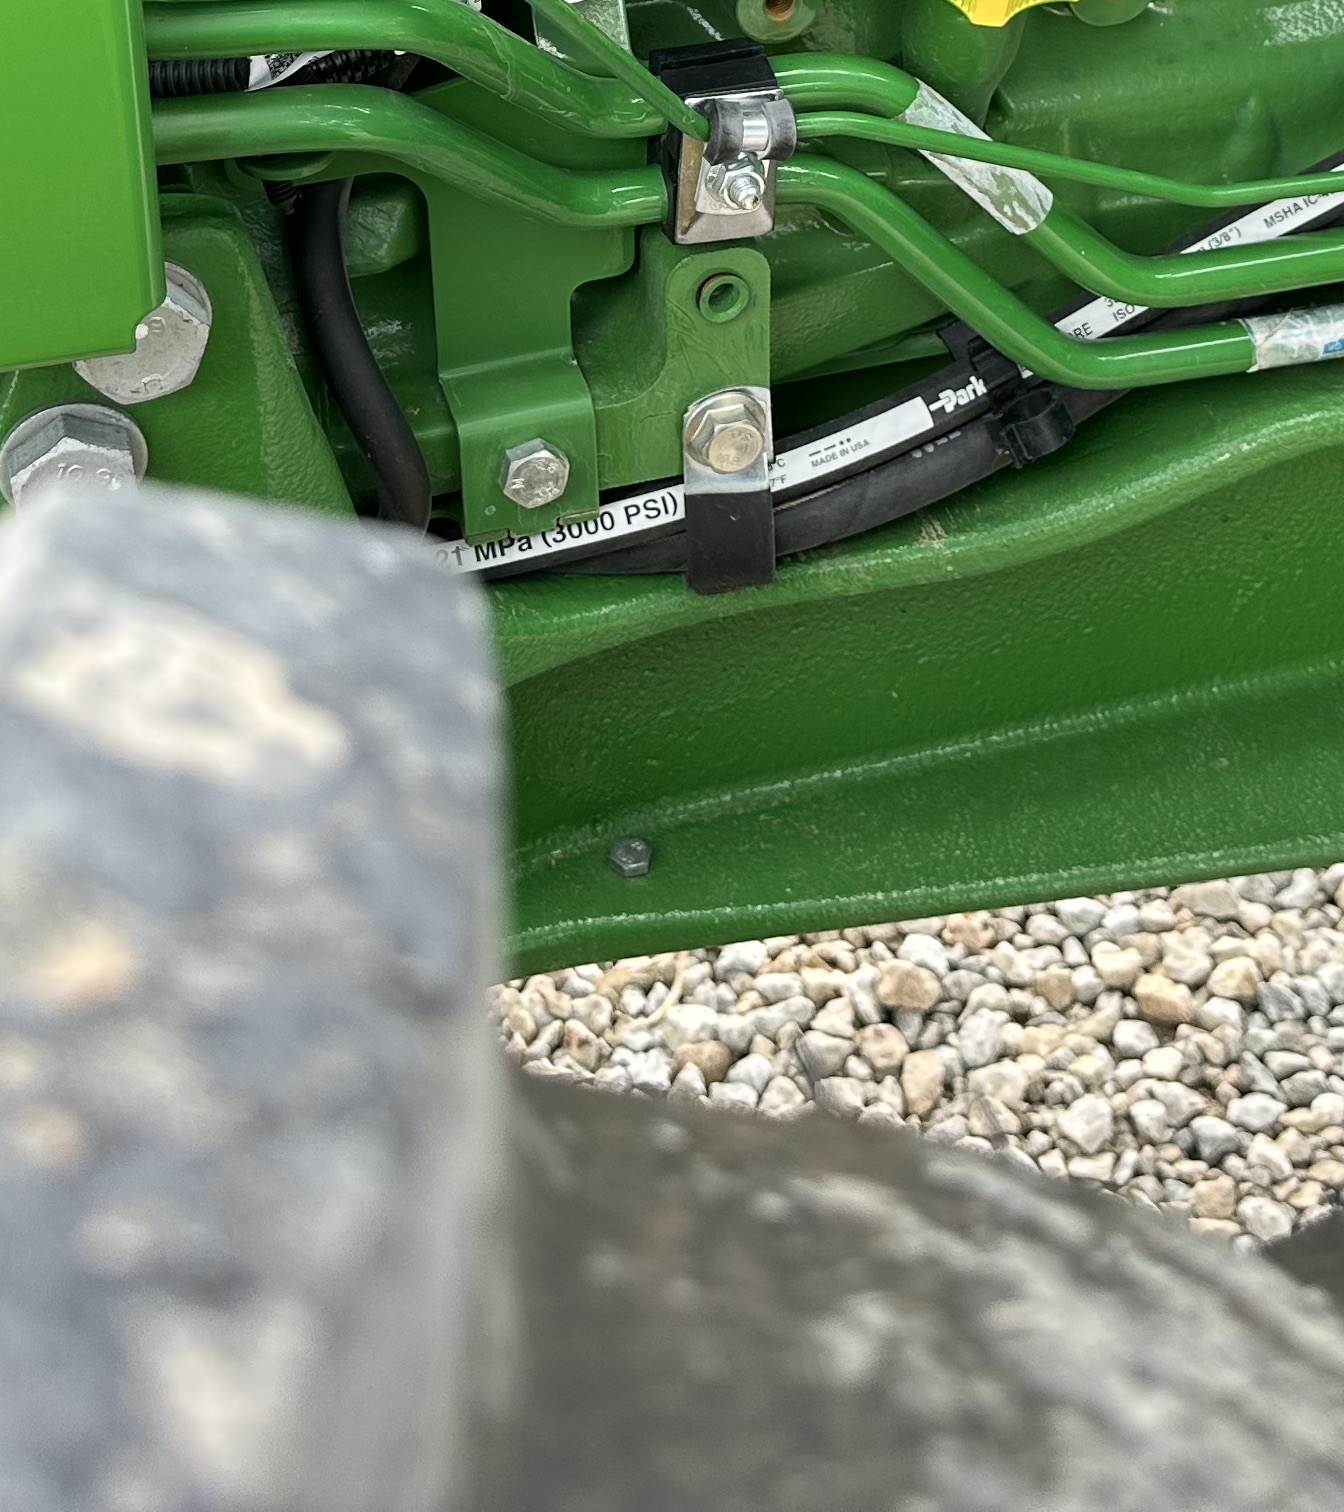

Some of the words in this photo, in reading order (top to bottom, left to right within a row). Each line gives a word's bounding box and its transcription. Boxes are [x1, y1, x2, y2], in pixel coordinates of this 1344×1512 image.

[1262, 201, 1304, 229] MSHA
[1111, 303, 1136, 323] ISO
[927, 374, 989, 414] Park
[810, 451, 839, 468] MADE
[839, 447, 851, 458] IN
[850, 438, 871, 453] USA
[473, 534, 533, 563] MPa
[541, 510, 616, 549] (3000
[623, 491, 678, 526] PSI)
